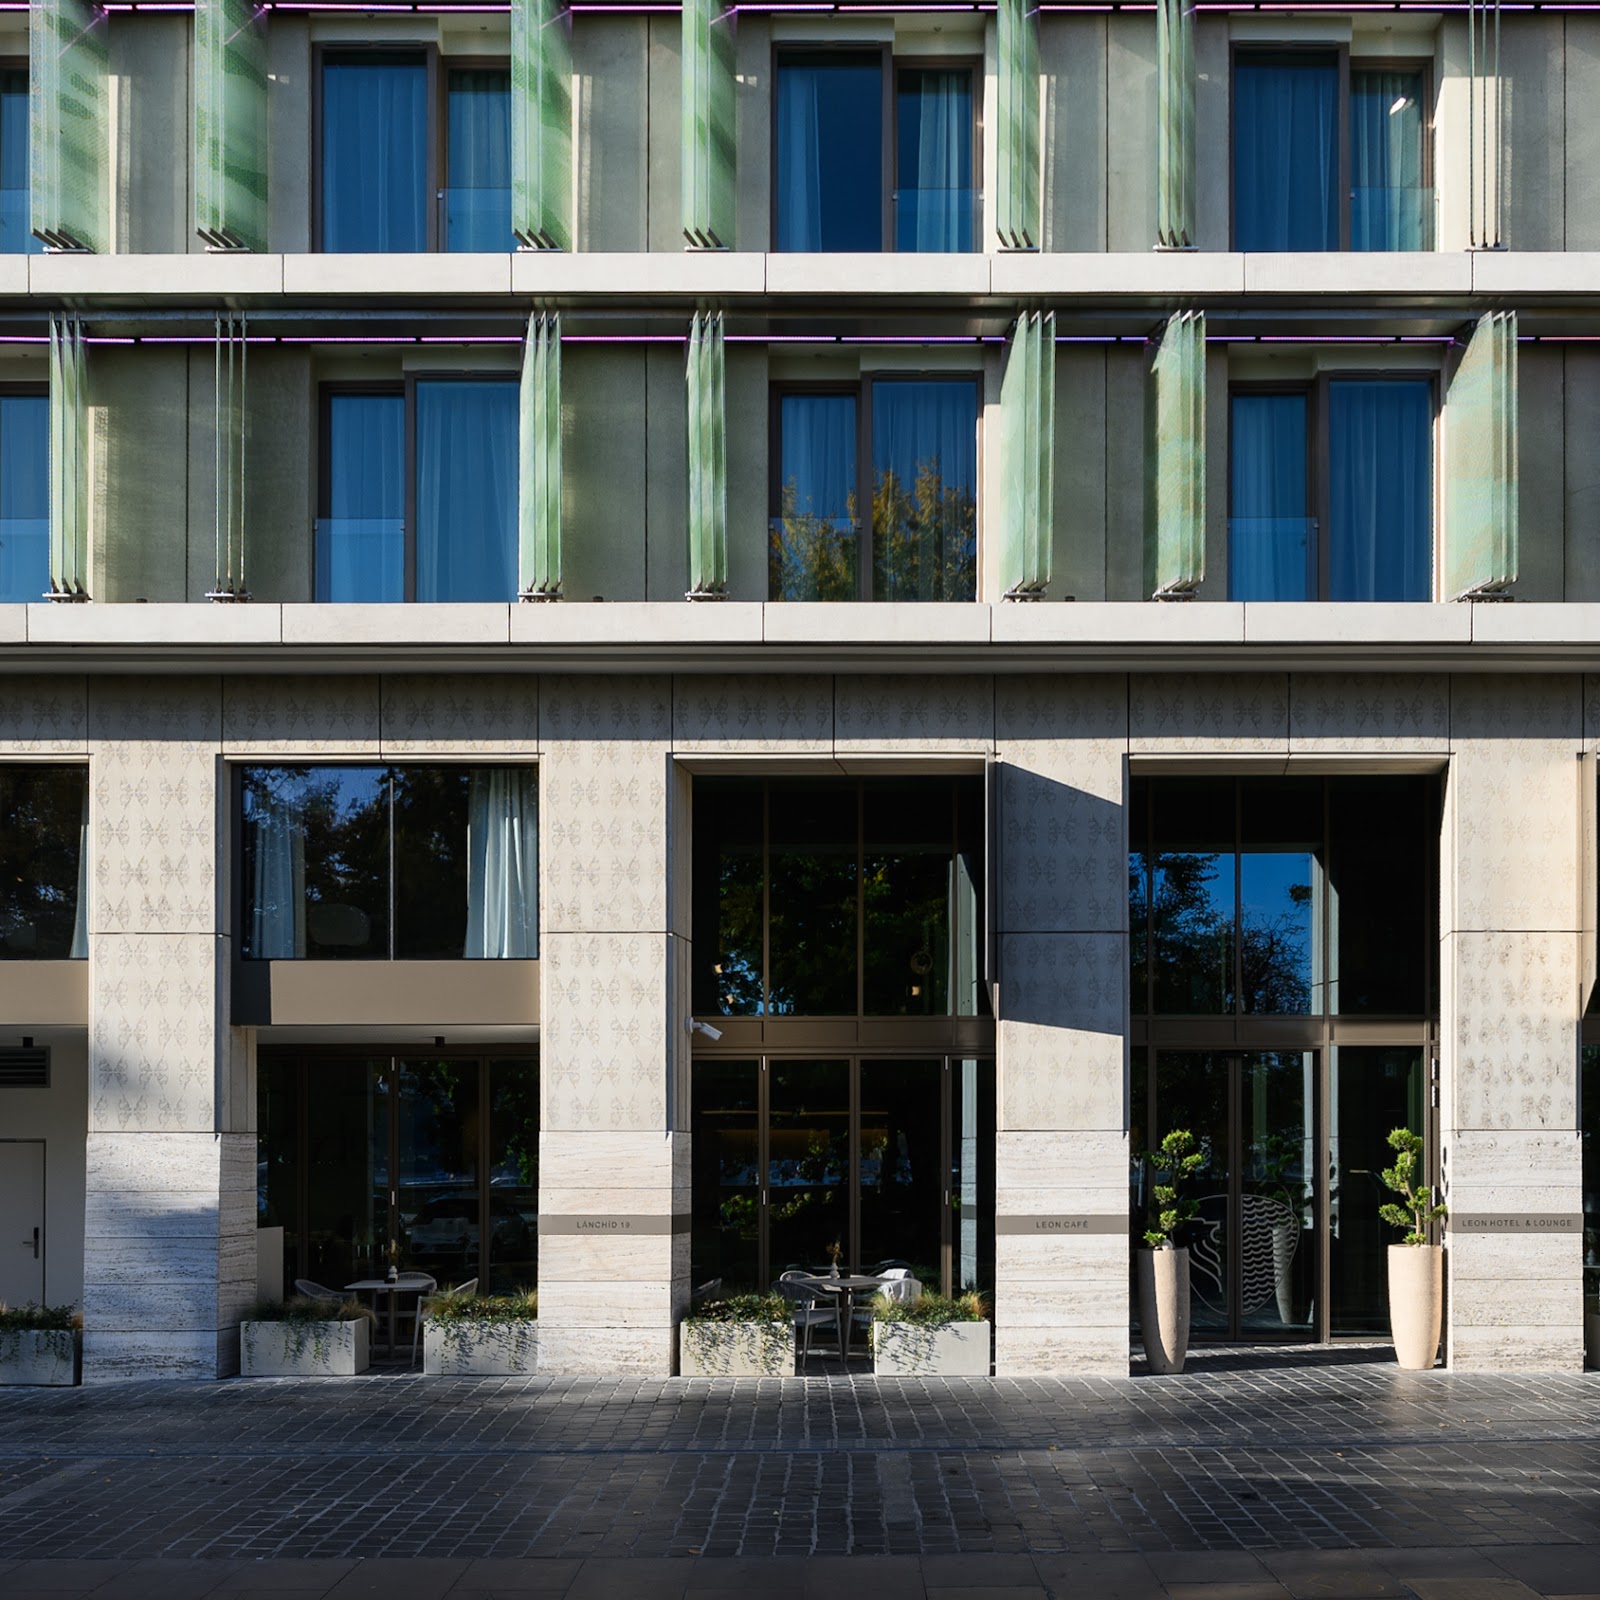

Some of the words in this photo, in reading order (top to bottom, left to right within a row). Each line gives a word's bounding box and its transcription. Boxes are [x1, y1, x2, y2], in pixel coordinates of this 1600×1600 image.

[1035, 1221, 1061, 1229] LEON
[1063, 1219, 1089, 1229] CAFÉ
[1462, 1219, 1487, 1227] LEON
[1489, 1219, 1521, 1227] HOTEL
[1525, 1219, 1531, 1227] &
[1533, 1219, 1573, 1227] LOUNGE
